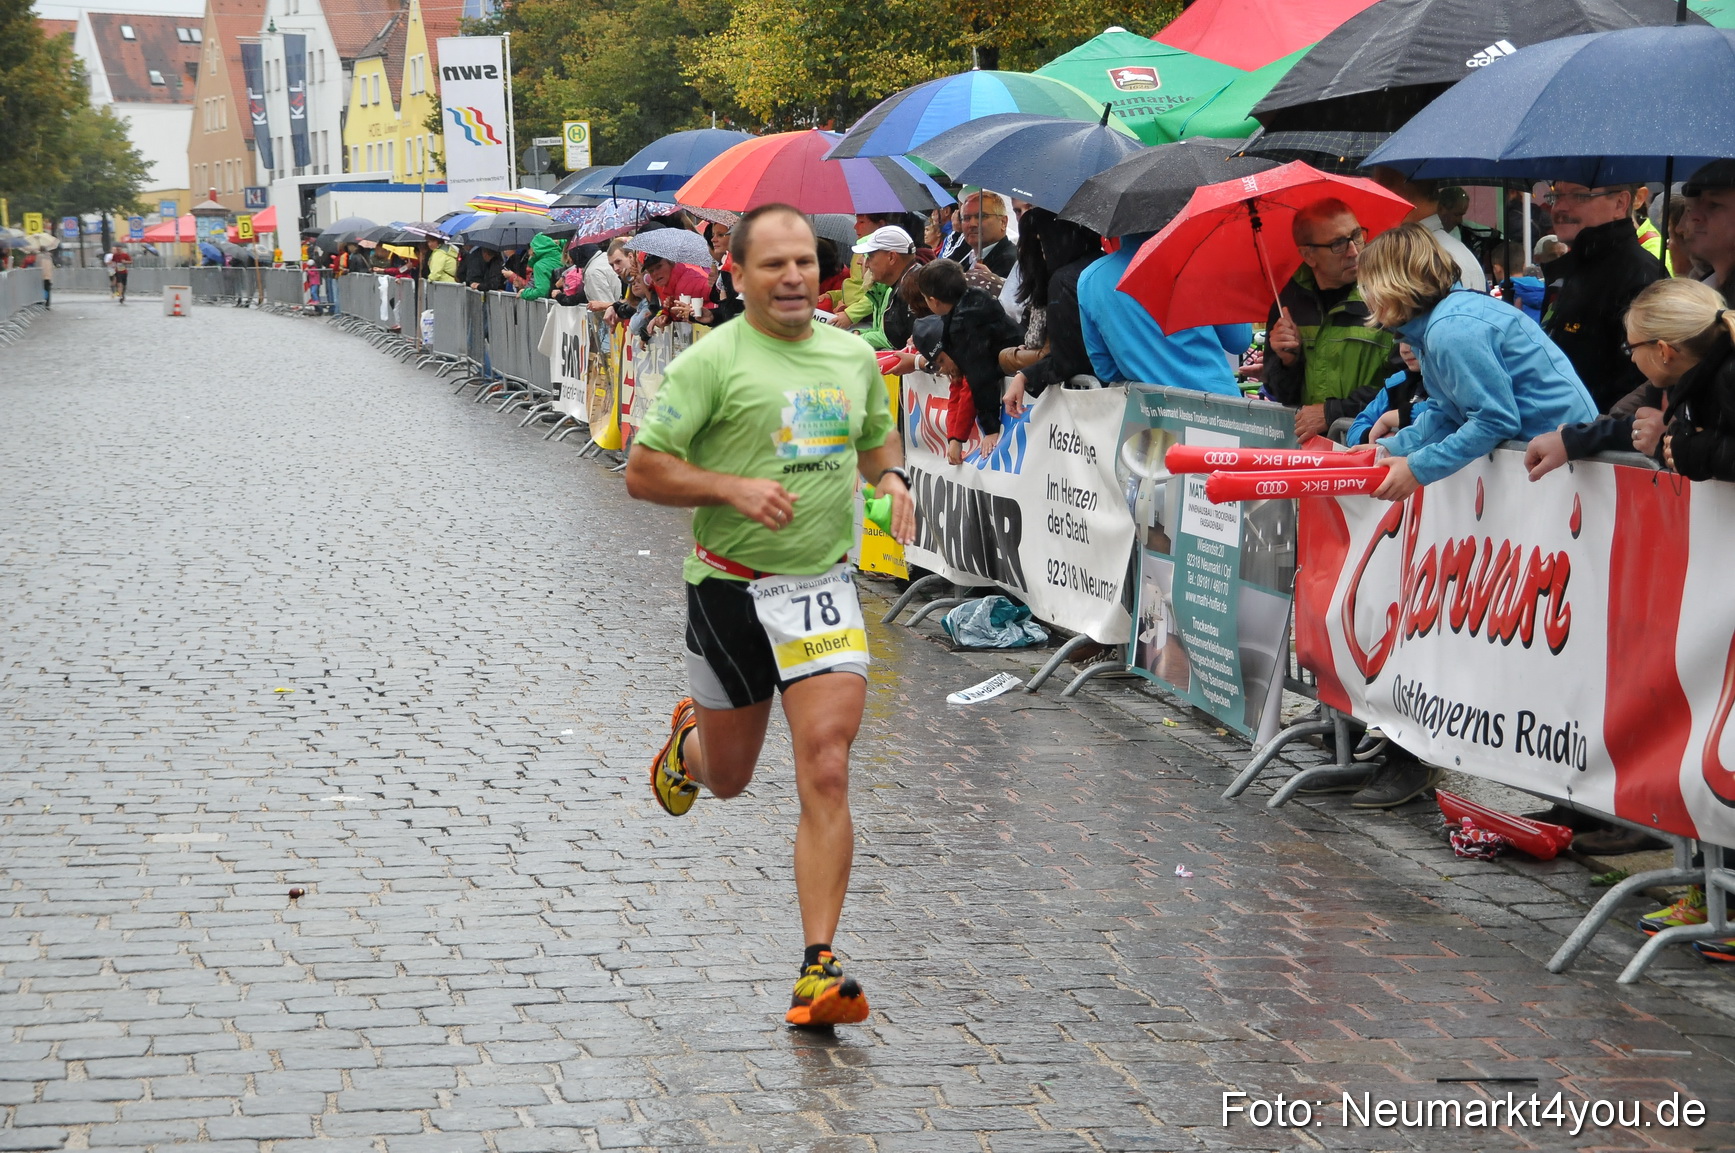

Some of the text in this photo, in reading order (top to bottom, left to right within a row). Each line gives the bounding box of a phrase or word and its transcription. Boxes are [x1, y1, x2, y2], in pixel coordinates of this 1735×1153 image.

[1466, 56, 1500, 67] adi
[30, 220, 39, 232] D
[242, 222, 251, 234] D
[1252, 454, 1324, 467] Audi BKK
[1046, 473, 1098, 511] Im Herzen
[1189, 481, 1209, 501] MATH
[1301, 478, 1367, 492] Audi BKK
[1047, 508, 1090, 545] der Stadt
[1047, 558, 1078, 591] 92318
[1341, 476, 1582, 685] Charivari
[791, 591, 841, 631] 78
[803, 634, 851, 656] Robert
[1393, 673, 1587, 772] Ostbayerns Radio
